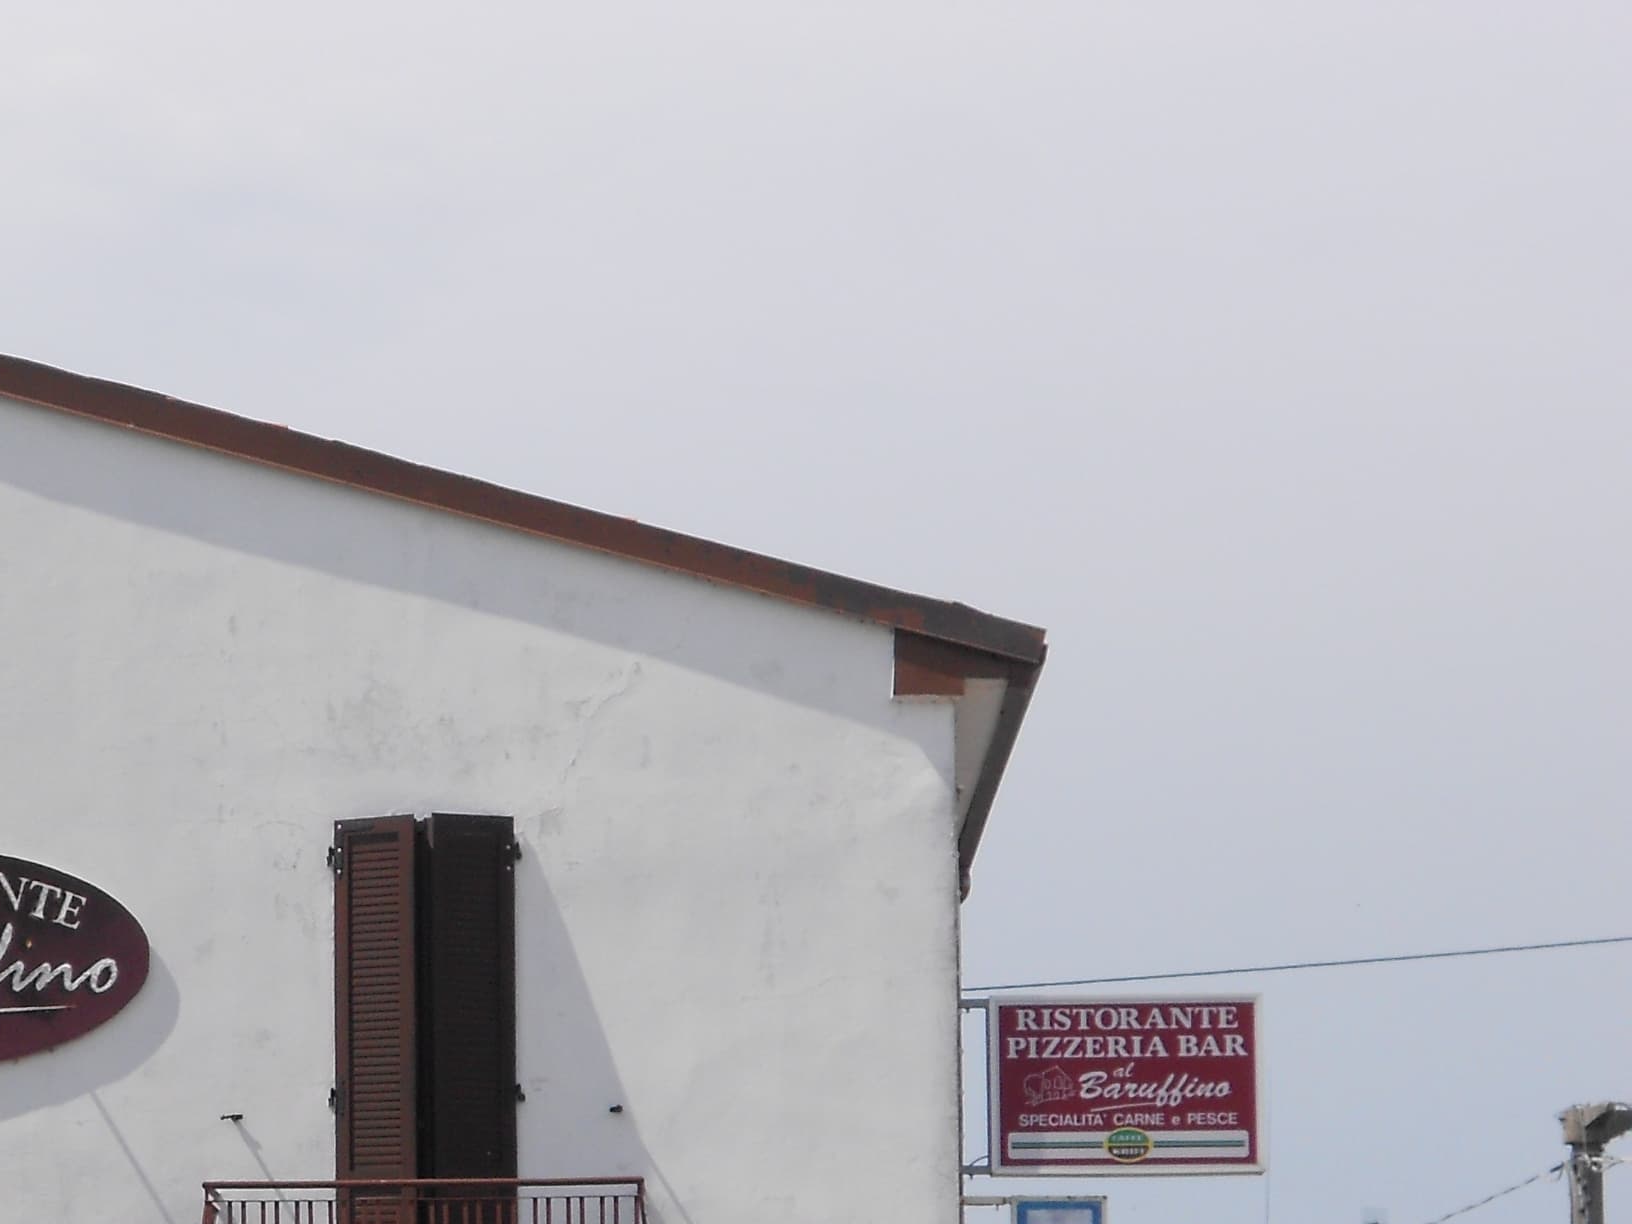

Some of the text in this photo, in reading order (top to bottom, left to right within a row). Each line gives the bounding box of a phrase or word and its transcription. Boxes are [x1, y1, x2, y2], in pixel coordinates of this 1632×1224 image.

[1016, 1006, 1239, 1031] RISTORANTE
[1006, 1034, 1248, 1058] PIZZERIA BAR
[1112, 1061, 1134, 1078] al
[1078, 1071, 1233, 1107] Baruffino
[1018, 1112, 1238, 1127] SPECIALITA' CARNE e PESCE
